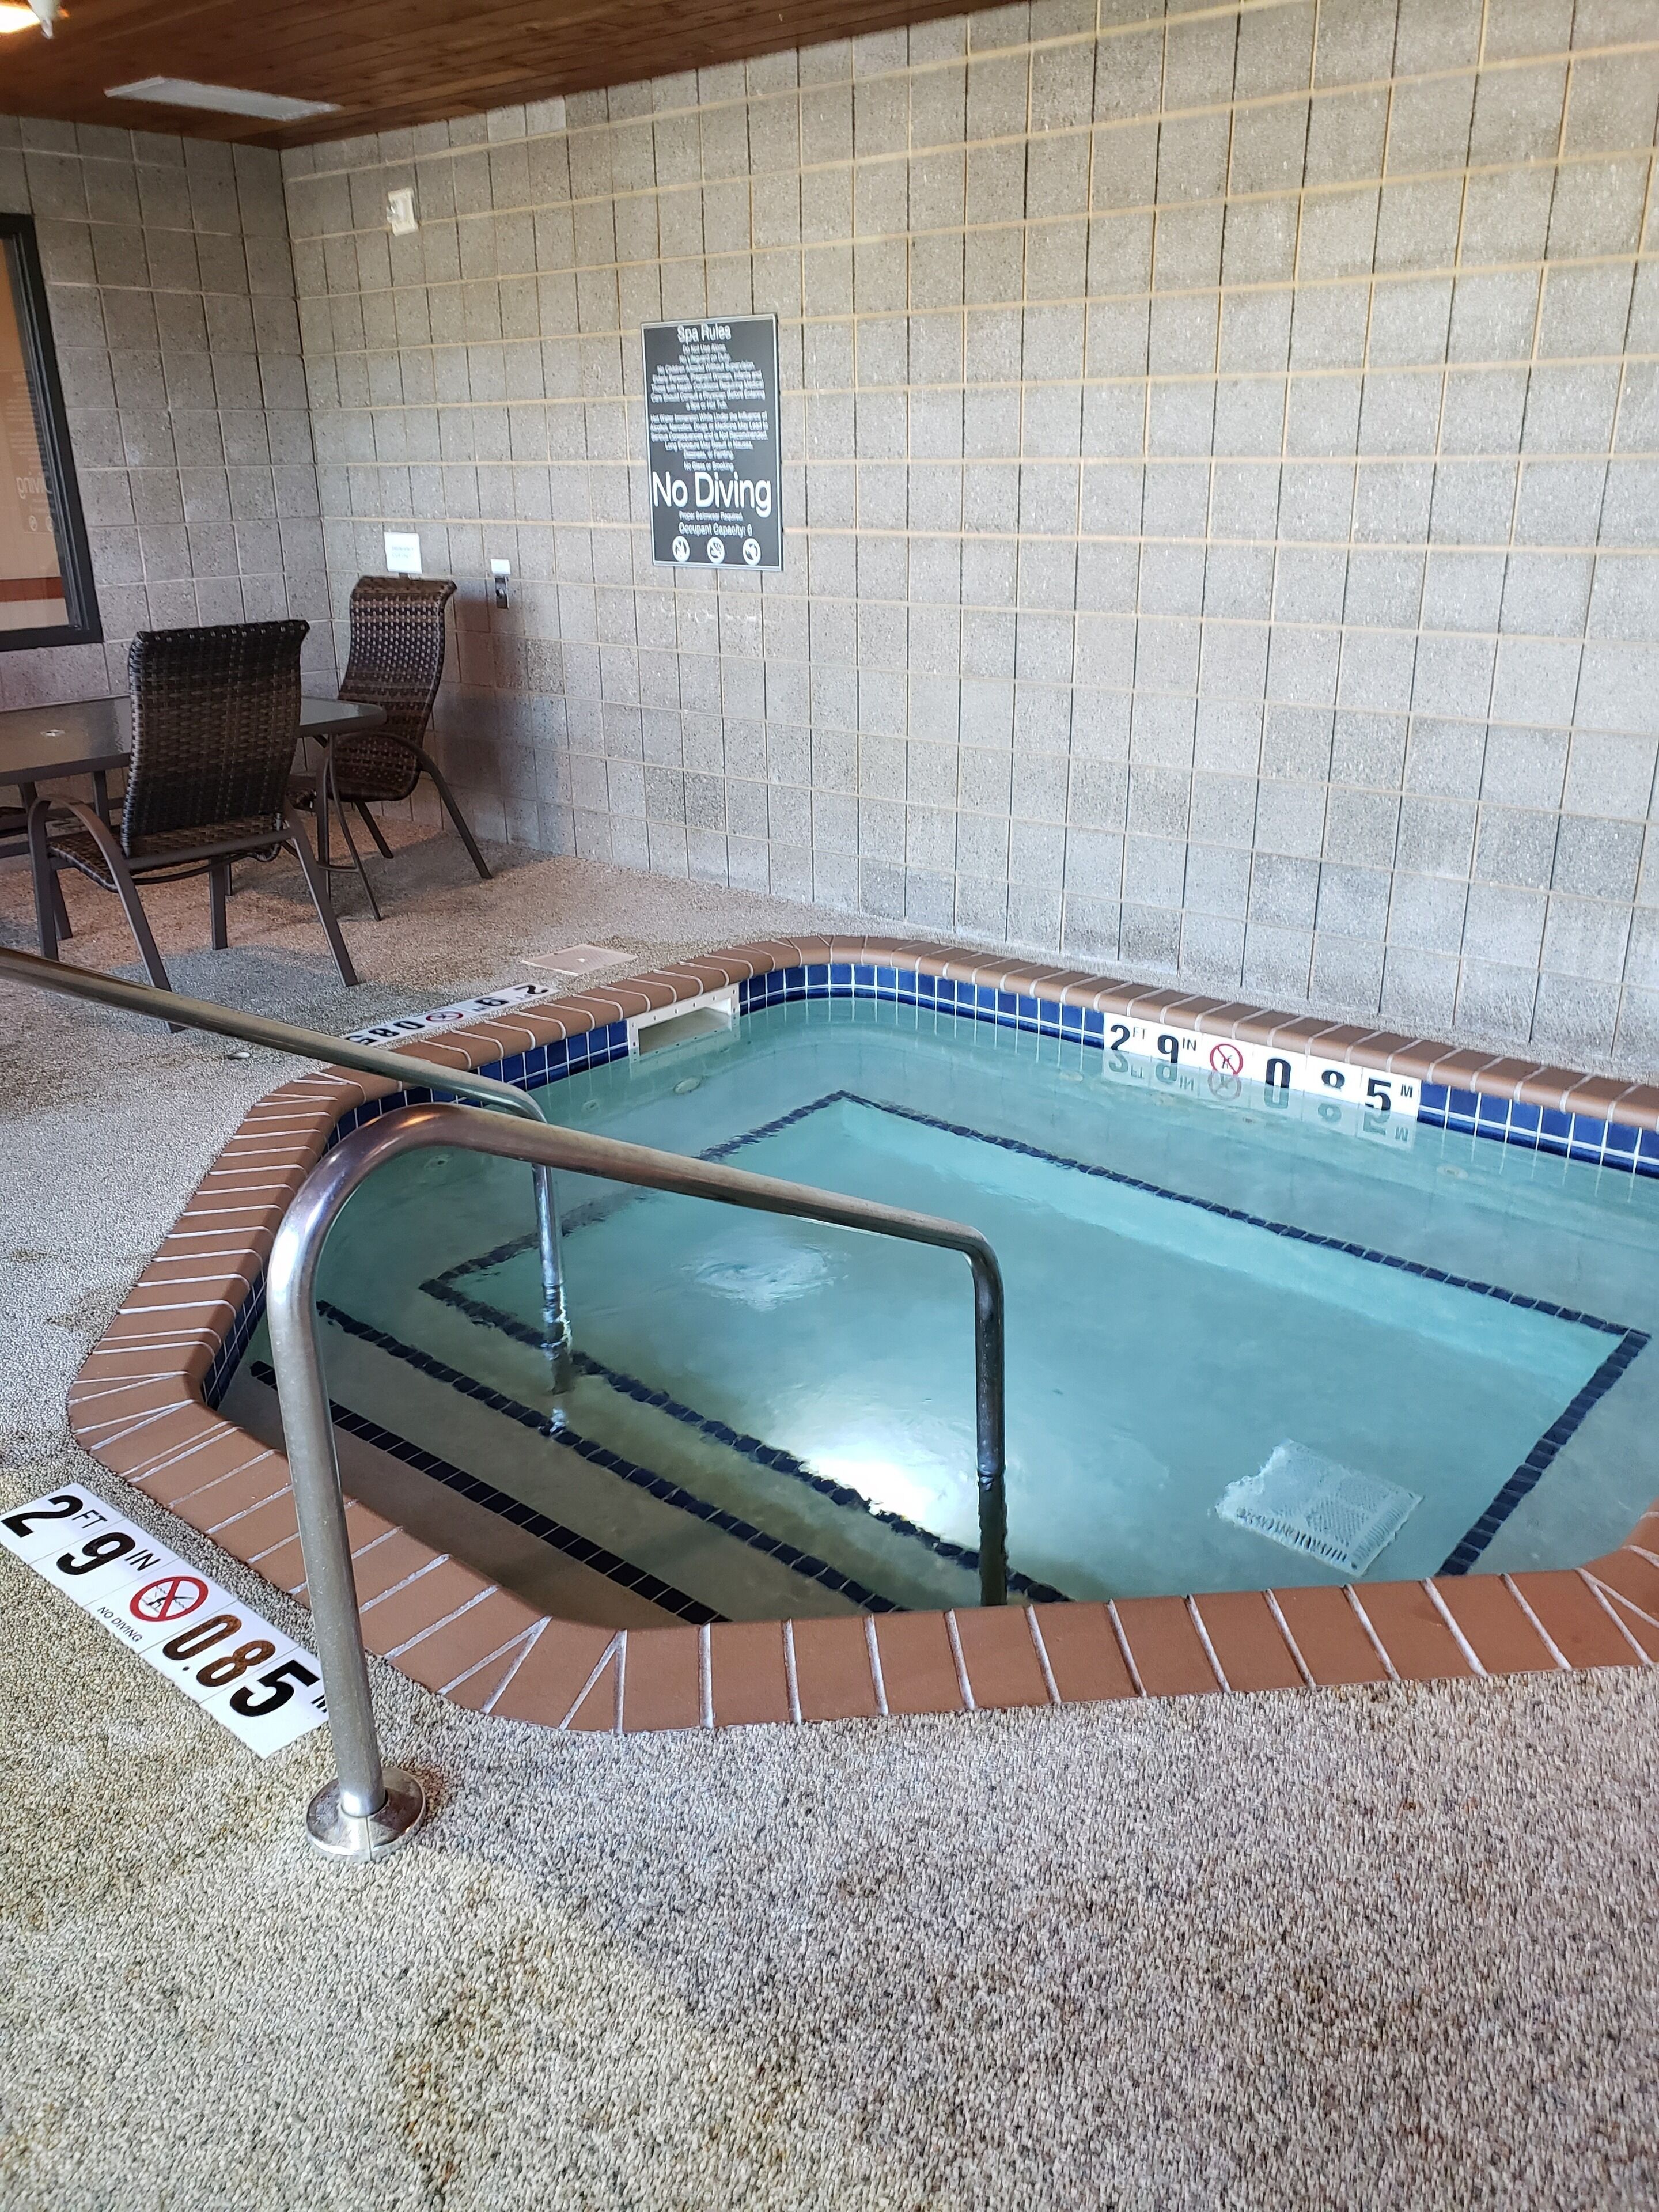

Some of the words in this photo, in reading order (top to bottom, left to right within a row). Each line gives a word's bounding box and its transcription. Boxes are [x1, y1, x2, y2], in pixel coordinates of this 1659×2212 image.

[677, 324, 699, 344] Spa
[701, 323, 732, 341] Rules
[652, 471, 688, 507] No
[695, 471, 771, 518] Diving
[679, 522, 711, 536] Occupant
[1111, 1024, 1130, 1050] 2
[1133, 1027, 1147, 1039] FT
[1158, 1035, 1179, 1063] 9
[1183, 1037, 1196, 1051] IN
[1400, 1084, 1413, 1098] M
[1, 1495, 83, 1538] 2
[72, 1509, 108, 1529] FT
[56, 1531, 136, 1575] 9
[124, 1548, 161, 1571] IN
[97, 1607, 114, 1618] NO
[111, 1617, 143, 1642] DIVING
